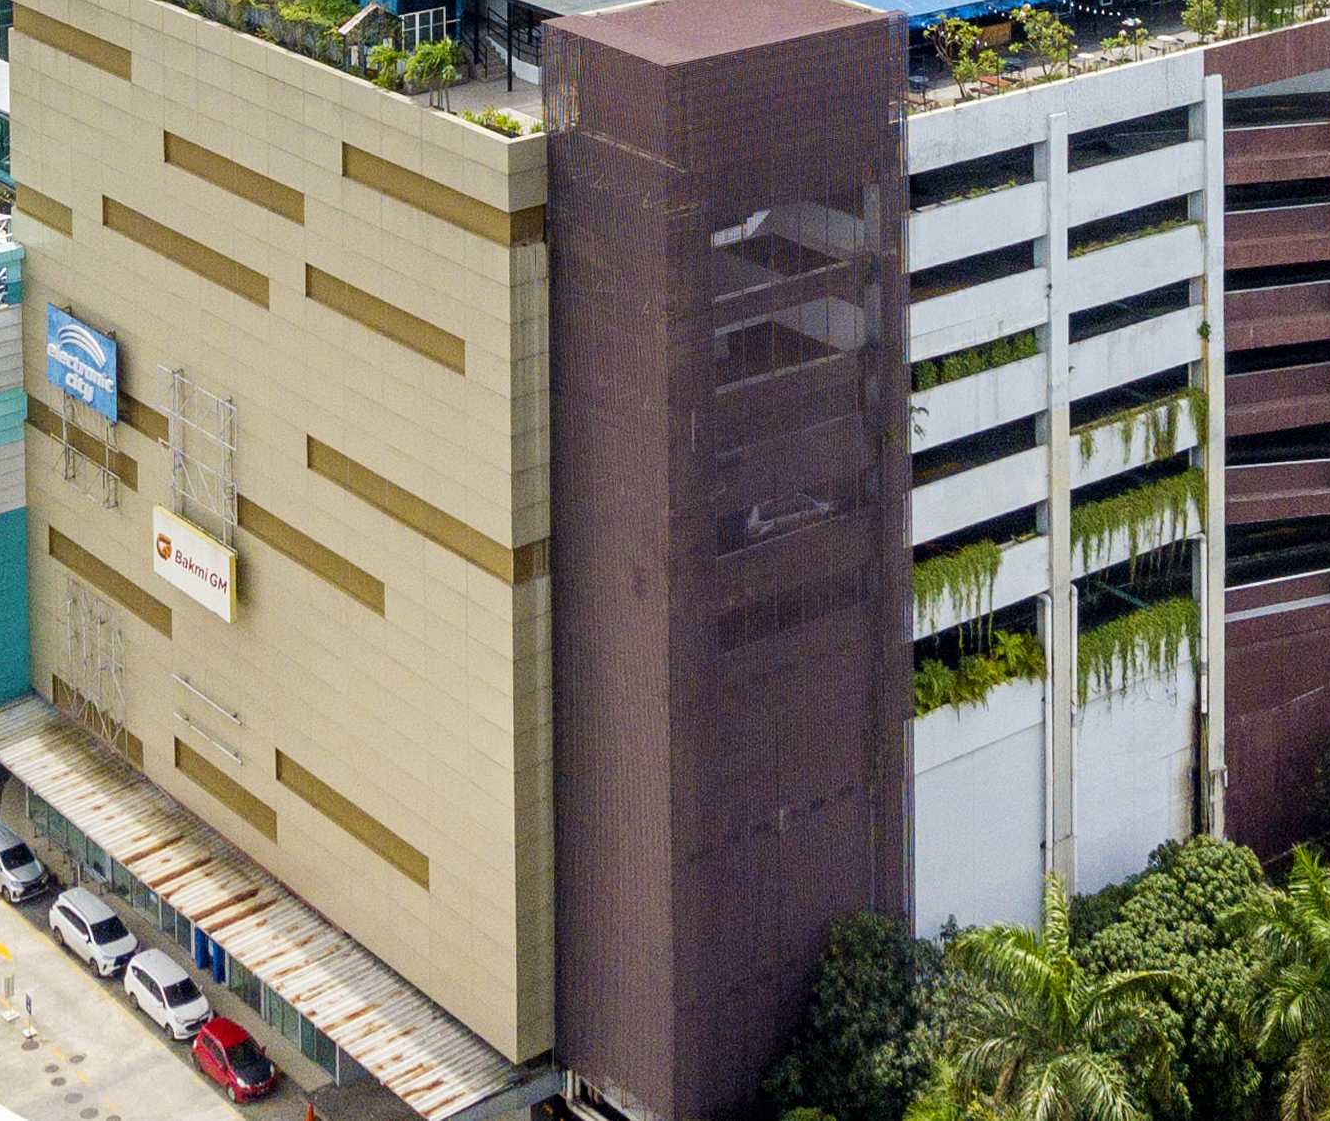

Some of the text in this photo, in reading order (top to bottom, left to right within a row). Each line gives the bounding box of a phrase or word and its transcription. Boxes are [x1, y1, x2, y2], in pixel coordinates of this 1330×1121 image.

[47, 343, 114, 393] electronic
[65, 372, 94, 403] city
[173, 549, 229, 596] Bakmi GM
